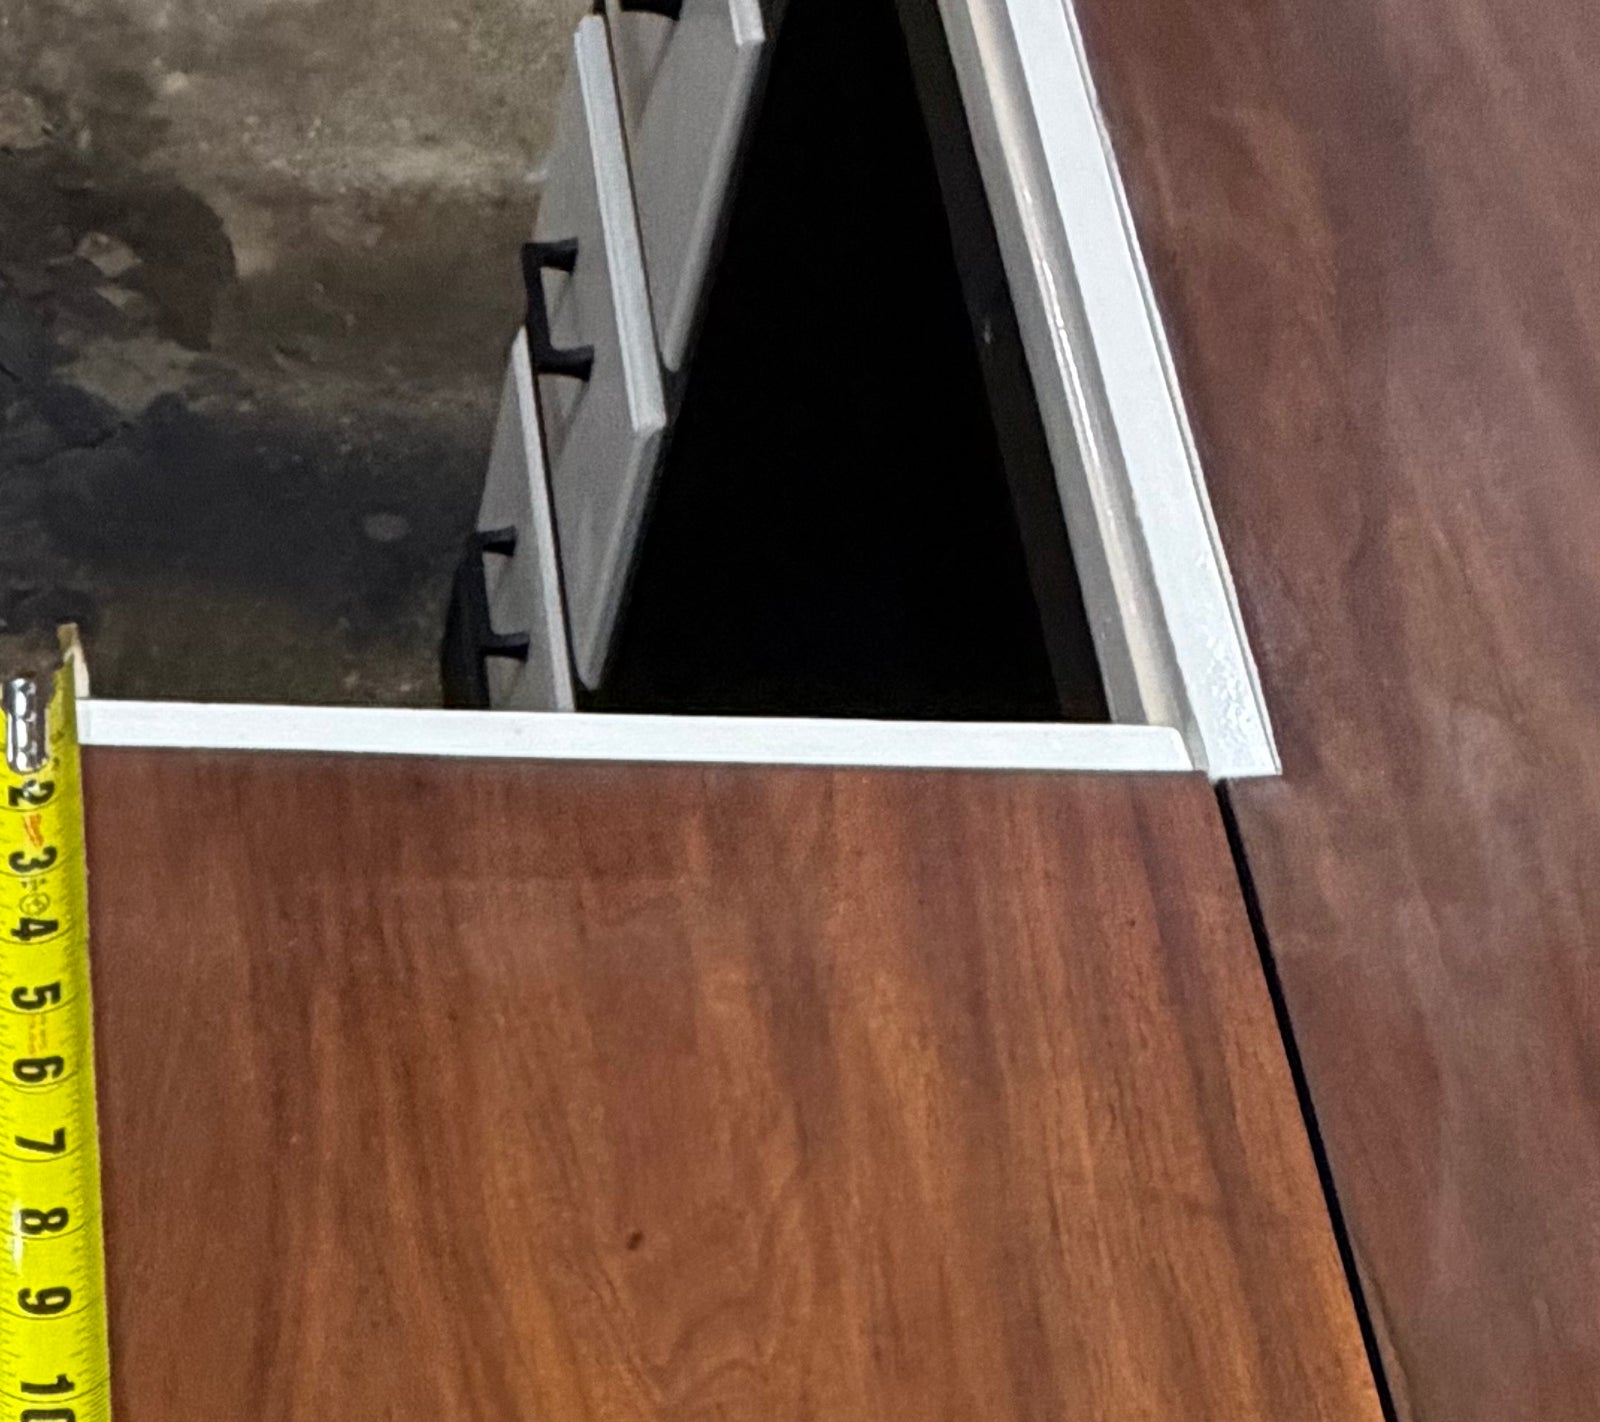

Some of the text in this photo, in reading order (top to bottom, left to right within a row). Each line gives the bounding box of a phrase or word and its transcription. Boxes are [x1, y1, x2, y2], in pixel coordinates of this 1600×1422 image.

[8, 779, 55, 807] 2
[8, 846, 57, 873] 3
[11, 917, 59, 941] 4
[11, 981, 61, 1010] 5
[13, 1055, 64, 1083] 6
[14, 1127, 66, 1154] 7
[19, 1207, 69, 1235] 8
[18, 1286, 71, 1315] 9
